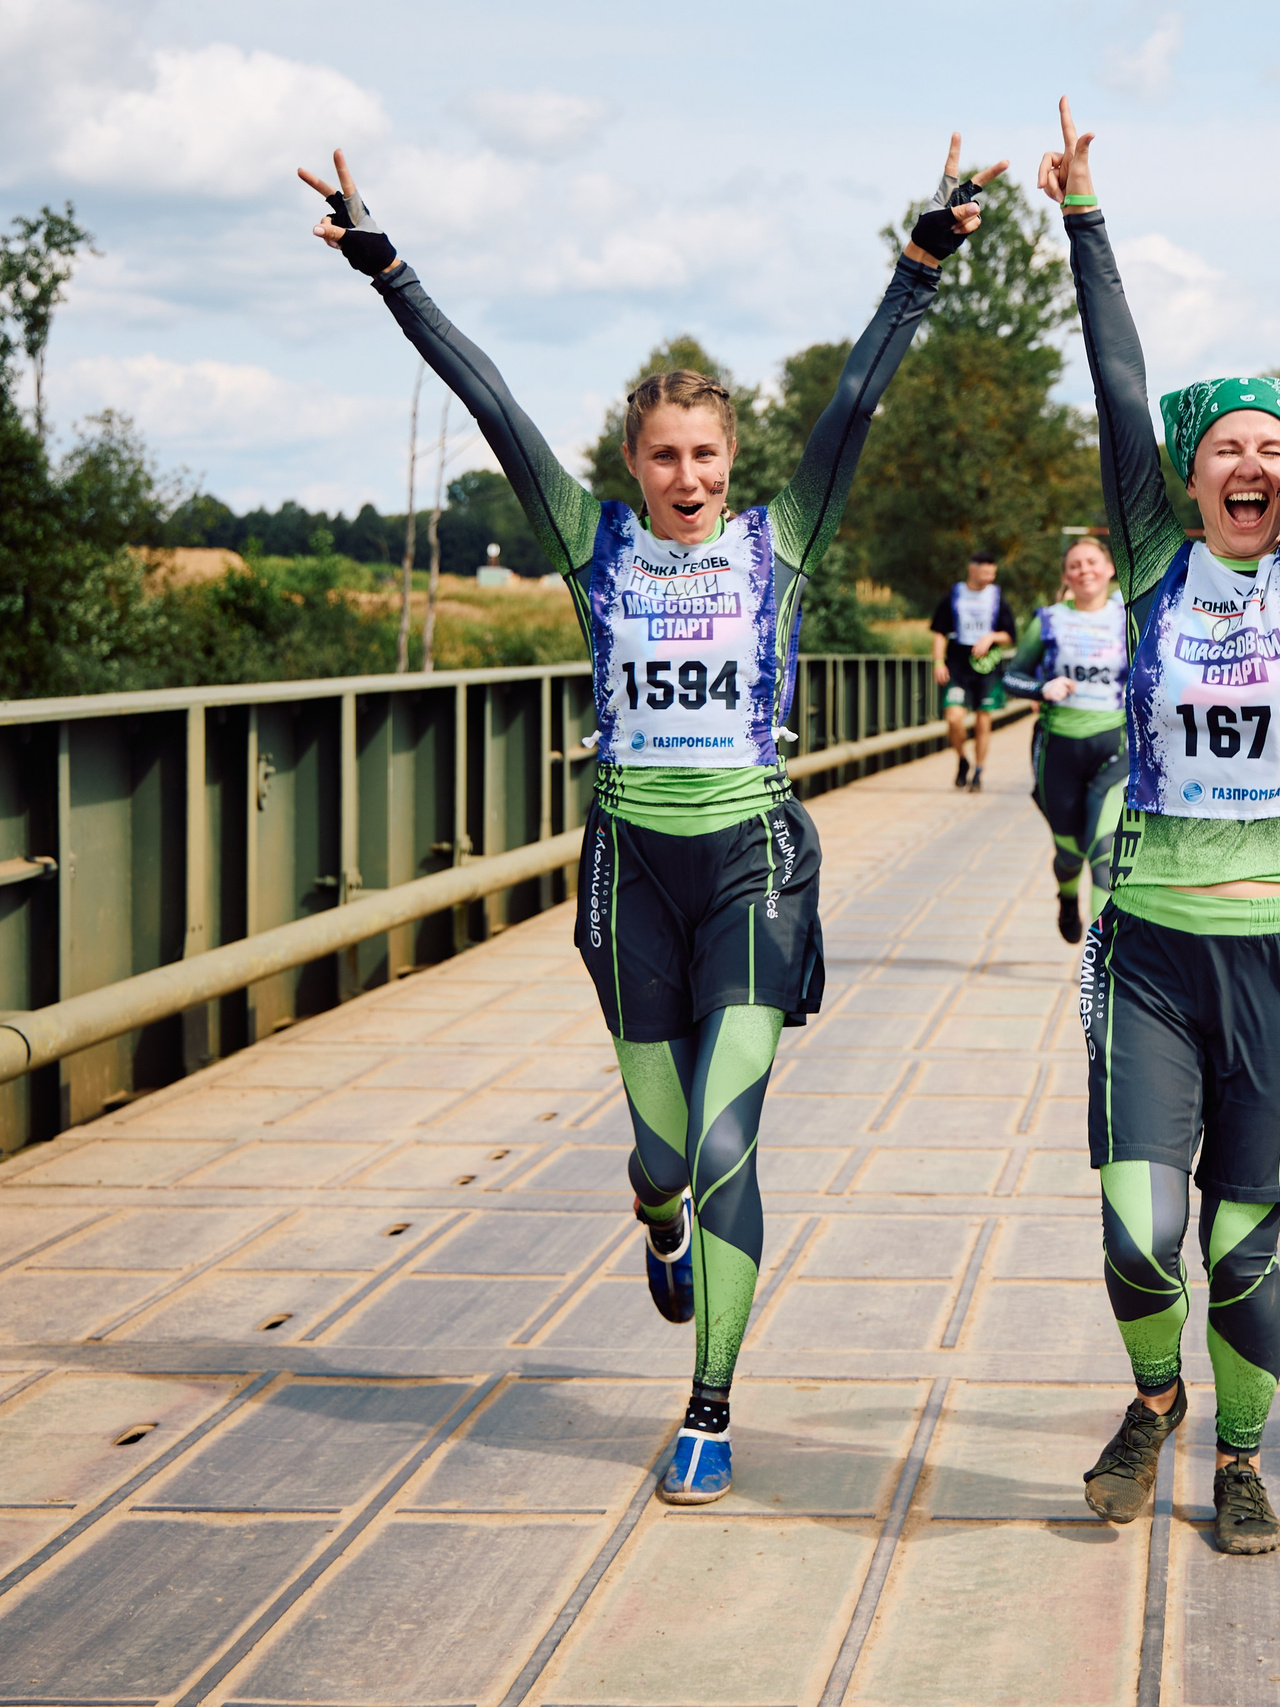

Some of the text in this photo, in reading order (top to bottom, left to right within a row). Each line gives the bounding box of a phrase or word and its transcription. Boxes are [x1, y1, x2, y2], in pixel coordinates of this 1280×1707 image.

[632, 555, 678, 577] ГОНКА
[625, 591, 738, 615] МАССОВЫЙ
[1193, 596, 1239, 615] ГОНКА
[651, 617, 711, 640] СТАРТ
[1206, 657, 1263, 686] СТАРТ
[621, 660, 741, 710] 1594
[652, 733, 735, 748] ГАЗПРОМБАНК
[589, 835, 607, 948] Greenway
[601, 863, 611, 915] GLOBAL
